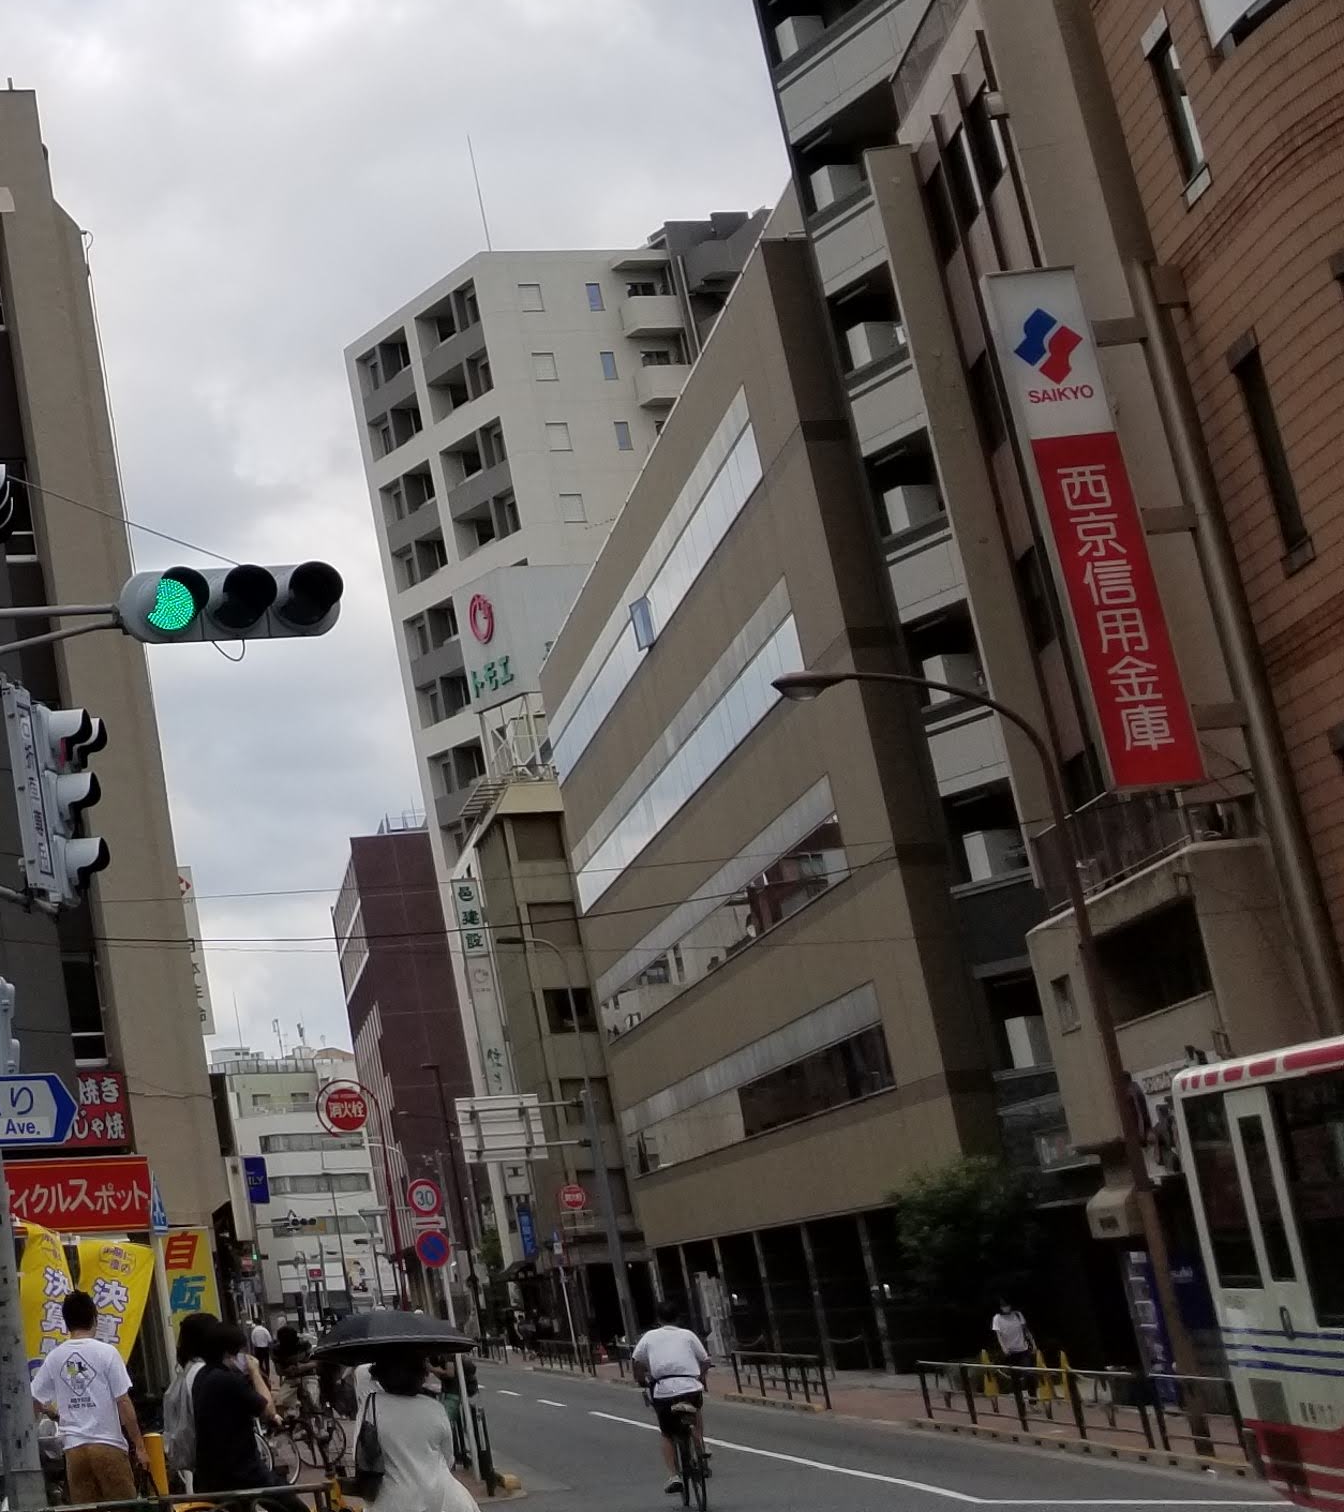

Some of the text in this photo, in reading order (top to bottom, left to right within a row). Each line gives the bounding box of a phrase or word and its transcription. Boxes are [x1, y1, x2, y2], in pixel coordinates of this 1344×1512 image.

[1029, 385, 1094, 405] SAIKYO
[1057, 463, 1175, 752] 西京信用金庫
[328, 1100, 365, 1119] 消火栓
[5, 1119, 41, 1138] Ave.
[68, 1111, 126, 1140] じゃ焼
[415, 1190, 434, 1207] 30
